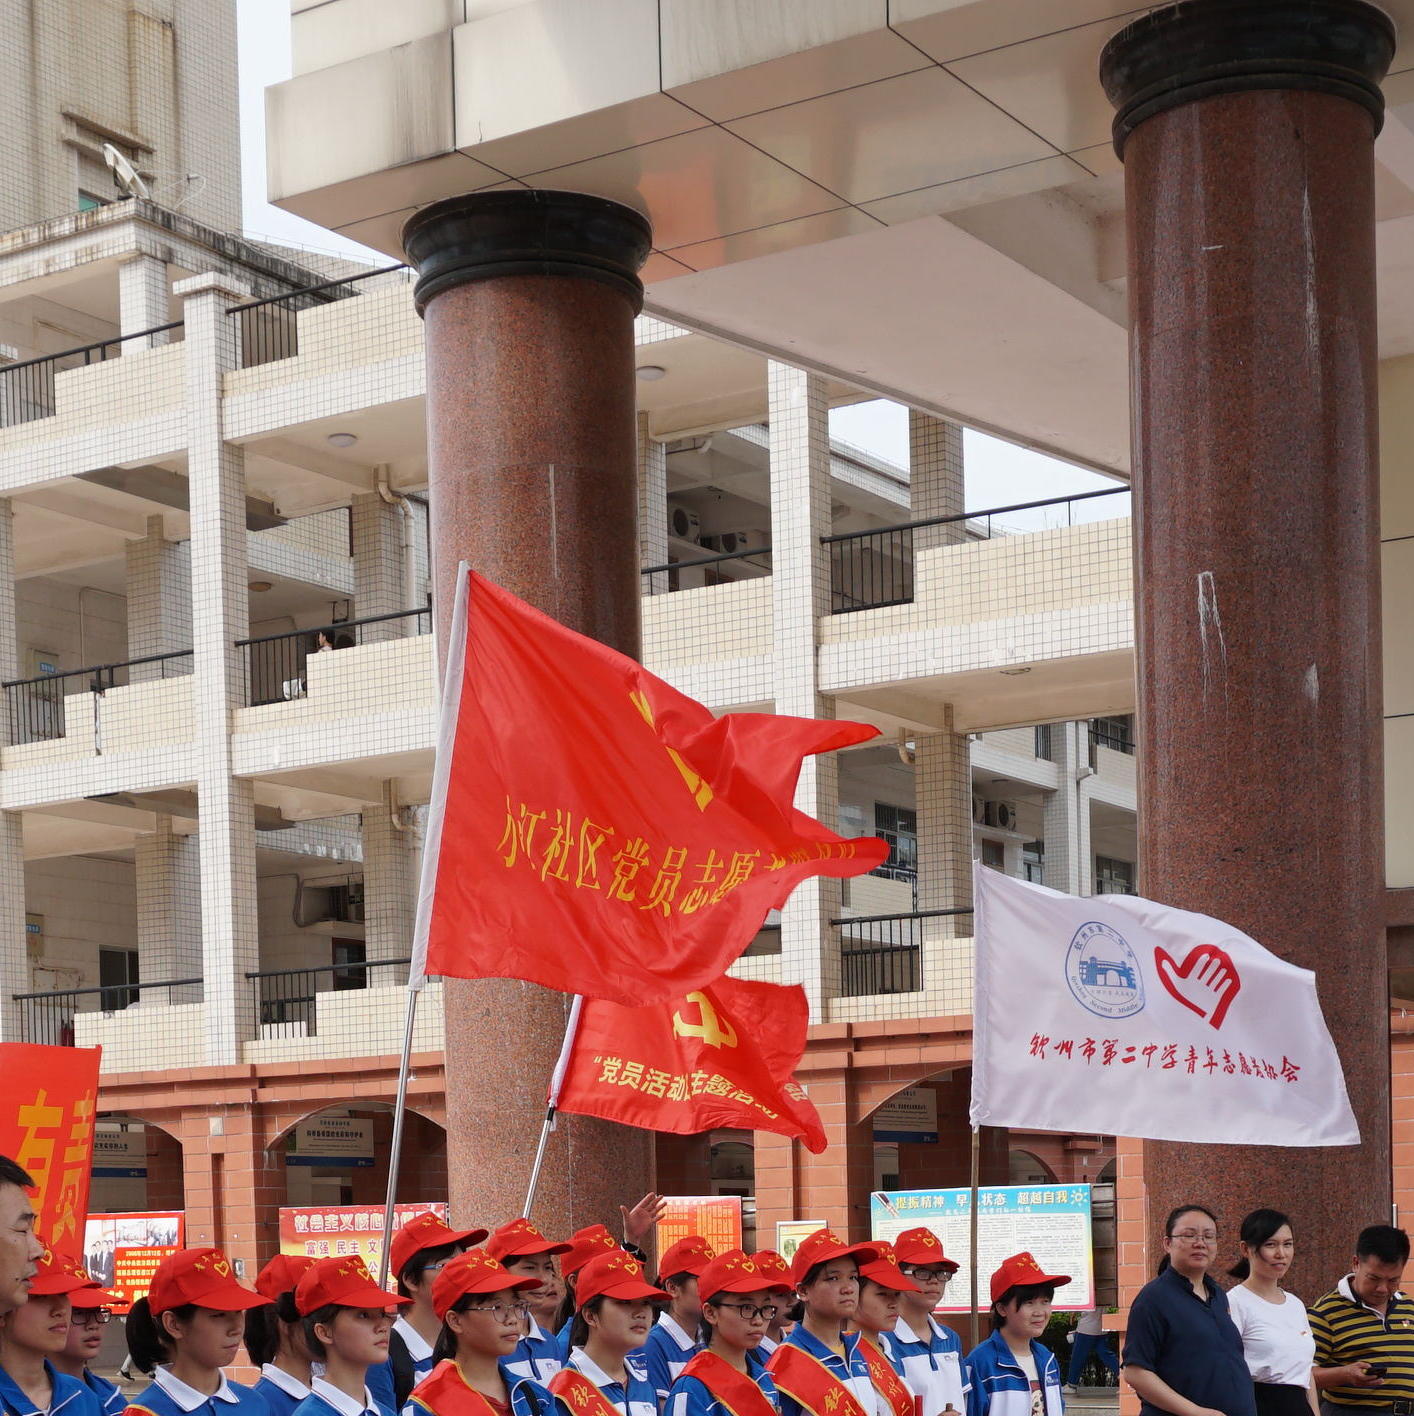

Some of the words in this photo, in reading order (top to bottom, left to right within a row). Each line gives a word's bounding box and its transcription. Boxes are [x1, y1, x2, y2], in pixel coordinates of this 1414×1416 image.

[956, 1192, 1007, 1208] 早状态
[1017, 1190, 1069, 1206] 超越自我
